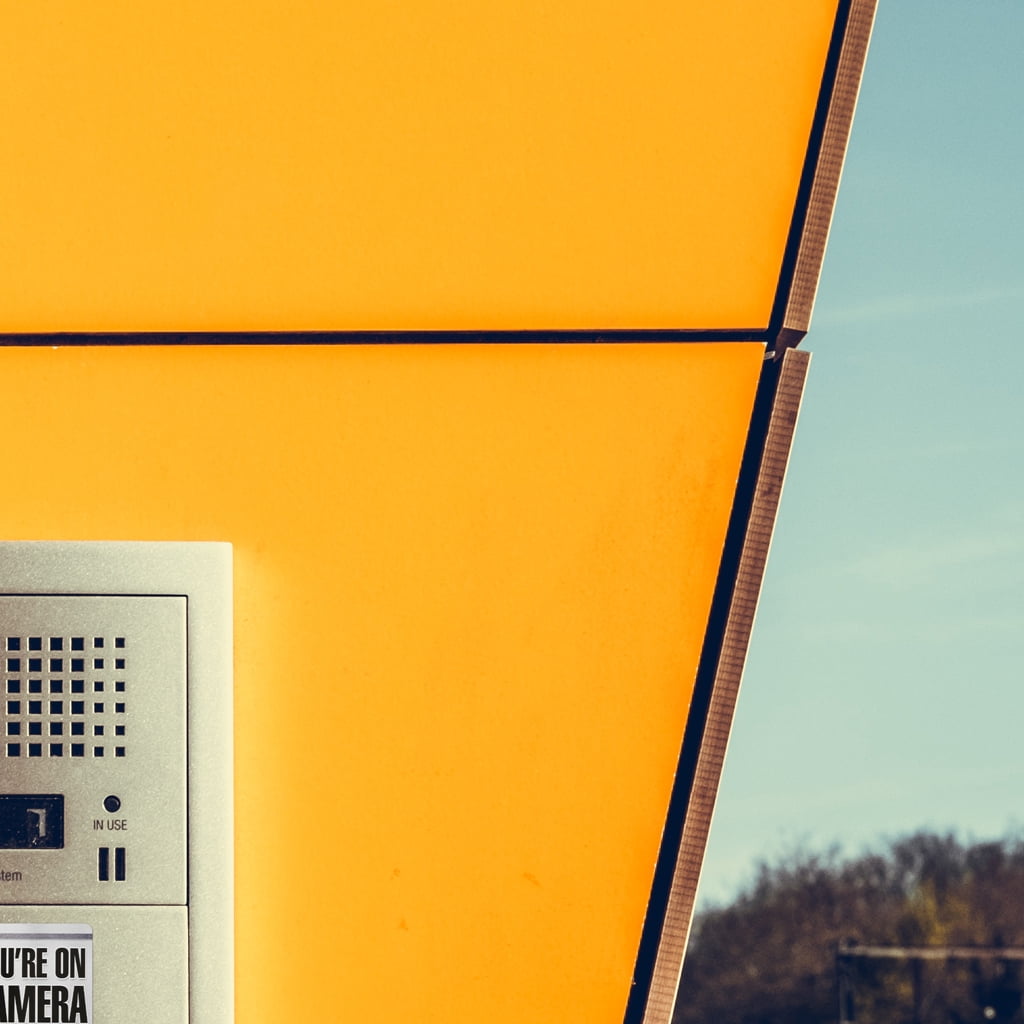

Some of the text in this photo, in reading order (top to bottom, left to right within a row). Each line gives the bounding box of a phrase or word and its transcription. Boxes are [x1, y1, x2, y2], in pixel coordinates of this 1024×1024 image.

[93, 820, 128, 831] IN USE
[55, 947, 86, 978] ON
